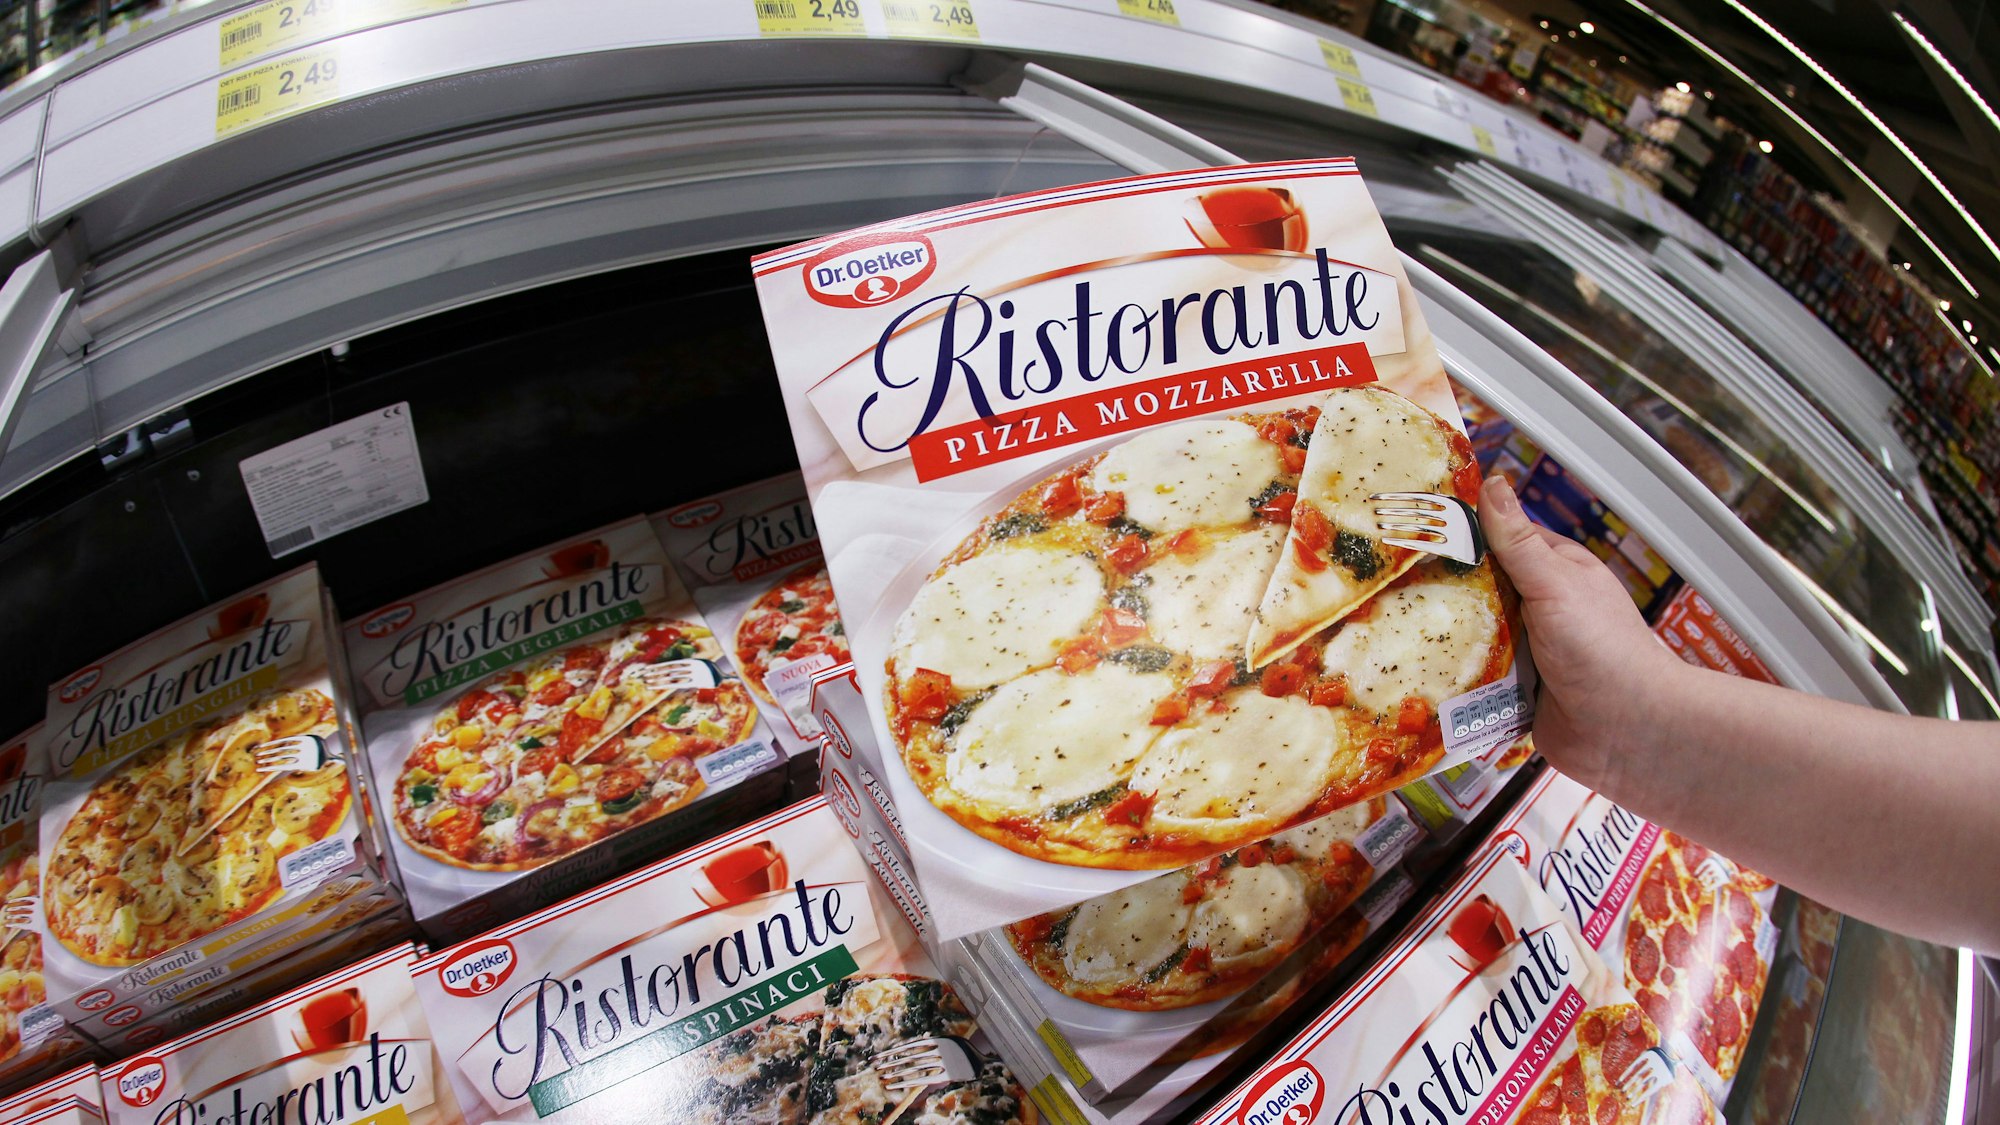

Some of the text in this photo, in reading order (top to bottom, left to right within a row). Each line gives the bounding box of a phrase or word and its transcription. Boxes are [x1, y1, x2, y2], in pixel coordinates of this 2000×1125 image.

[812, 0, 859, 21] 2,49
[929, 4, 974, 25] 2,49
[253, 65, 274, 77] PIZZA
[278, 58, 338, 96] 2,49
[815, 246, 924, 288] Dr.Oetker
[857, 247, 1380, 453] Ristorante
[943, 355, 1353, 464] PIZZA MOZZARELLA
[738, 557, 780, 579] PIZZA
[382, 561, 650, 698] Ristorante
[415, 605, 636, 700] PIZZA VEGETALE
[781, 659, 822, 682] NUOVA
[59, 618, 293, 768] Ristorante
[90, 678, 256, 766] PIZZA FUNGHI
[825, 714, 850, 752] Dr.Oetker
[833, 773, 858, 812] Dr.Oetker
[860, 770, 907, 842] Ristora
[869, 831, 931, 920] Ristorante
[1585, 909, 1614, 945] PIZZA
[120, 950, 200, 992] Ristorante
[224, 917, 280, 946] FUNGHI
[445, 949, 511, 986] Dr.Oetker
[150, 965, 225, 1006] Ristorante
[492, 878, 854, 1100] Ristorante
[683, 961, 827, 1045] SPINACI
[121, 1068, 161, 1094] Dr.Oetker
[1247, 1071, 1315, 1125] Dr.Oetker
